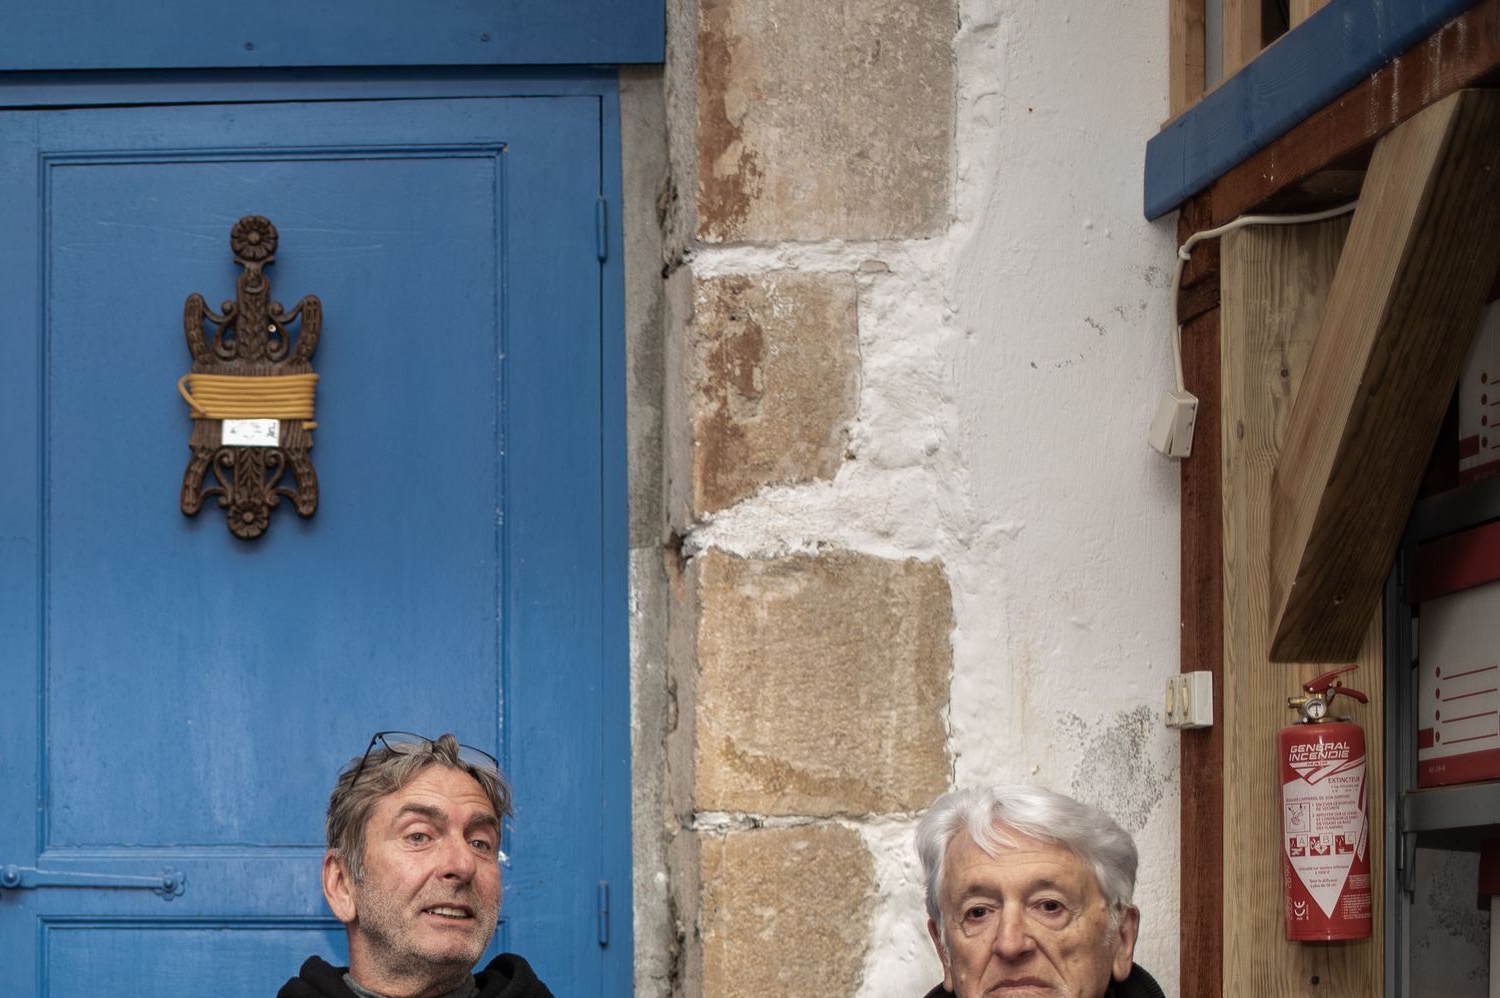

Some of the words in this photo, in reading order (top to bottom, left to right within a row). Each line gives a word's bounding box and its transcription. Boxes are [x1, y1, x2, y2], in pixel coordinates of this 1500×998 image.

[1290, 742, 1350, 753] GENERAL
[1289, 750, 1349, 762] INCENDIE
[1298, 836, 1306, 845] A
[1323, 835, 1330, 844] B
[1348, 833, 1354, 842] C
